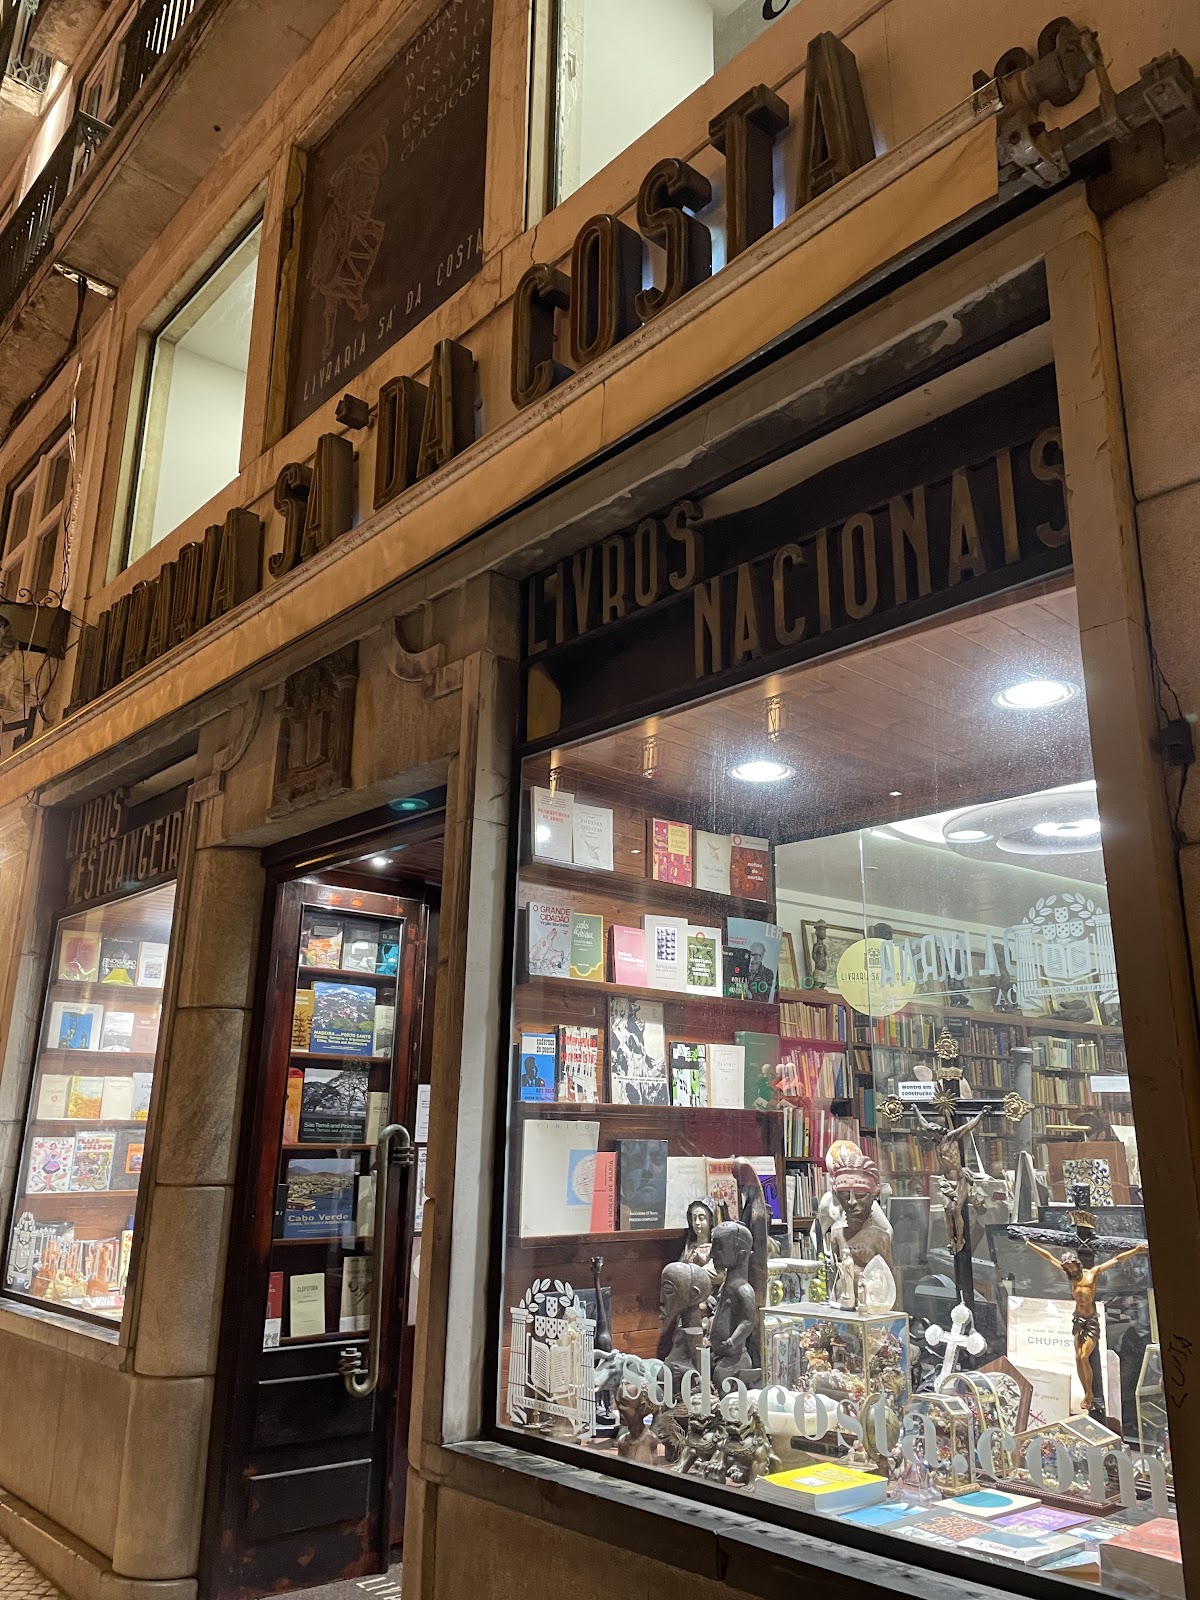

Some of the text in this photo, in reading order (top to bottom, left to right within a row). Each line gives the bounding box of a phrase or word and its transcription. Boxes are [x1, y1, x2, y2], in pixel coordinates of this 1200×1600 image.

[373, 338, 477, 511] DA
[511, 31, 877, 408] COSTA
[303, 332, 366, 402] LIVRARIA
[405, 289, 422, 316] DA
[436, 227, 484, 288] COSTA
[528, 500, 703, 657] LIVROS
[694, 426, 1072, 679] NACIONAIS
[66, 788, 124, 860] LIVROS
[532, 904, 571, 916] O GRANDE
[540, 913, 570, 923] CIDADÃO
[765, 923, 782, 940] LER
[1027, 1336, 1074, 1347] CHUPIS
